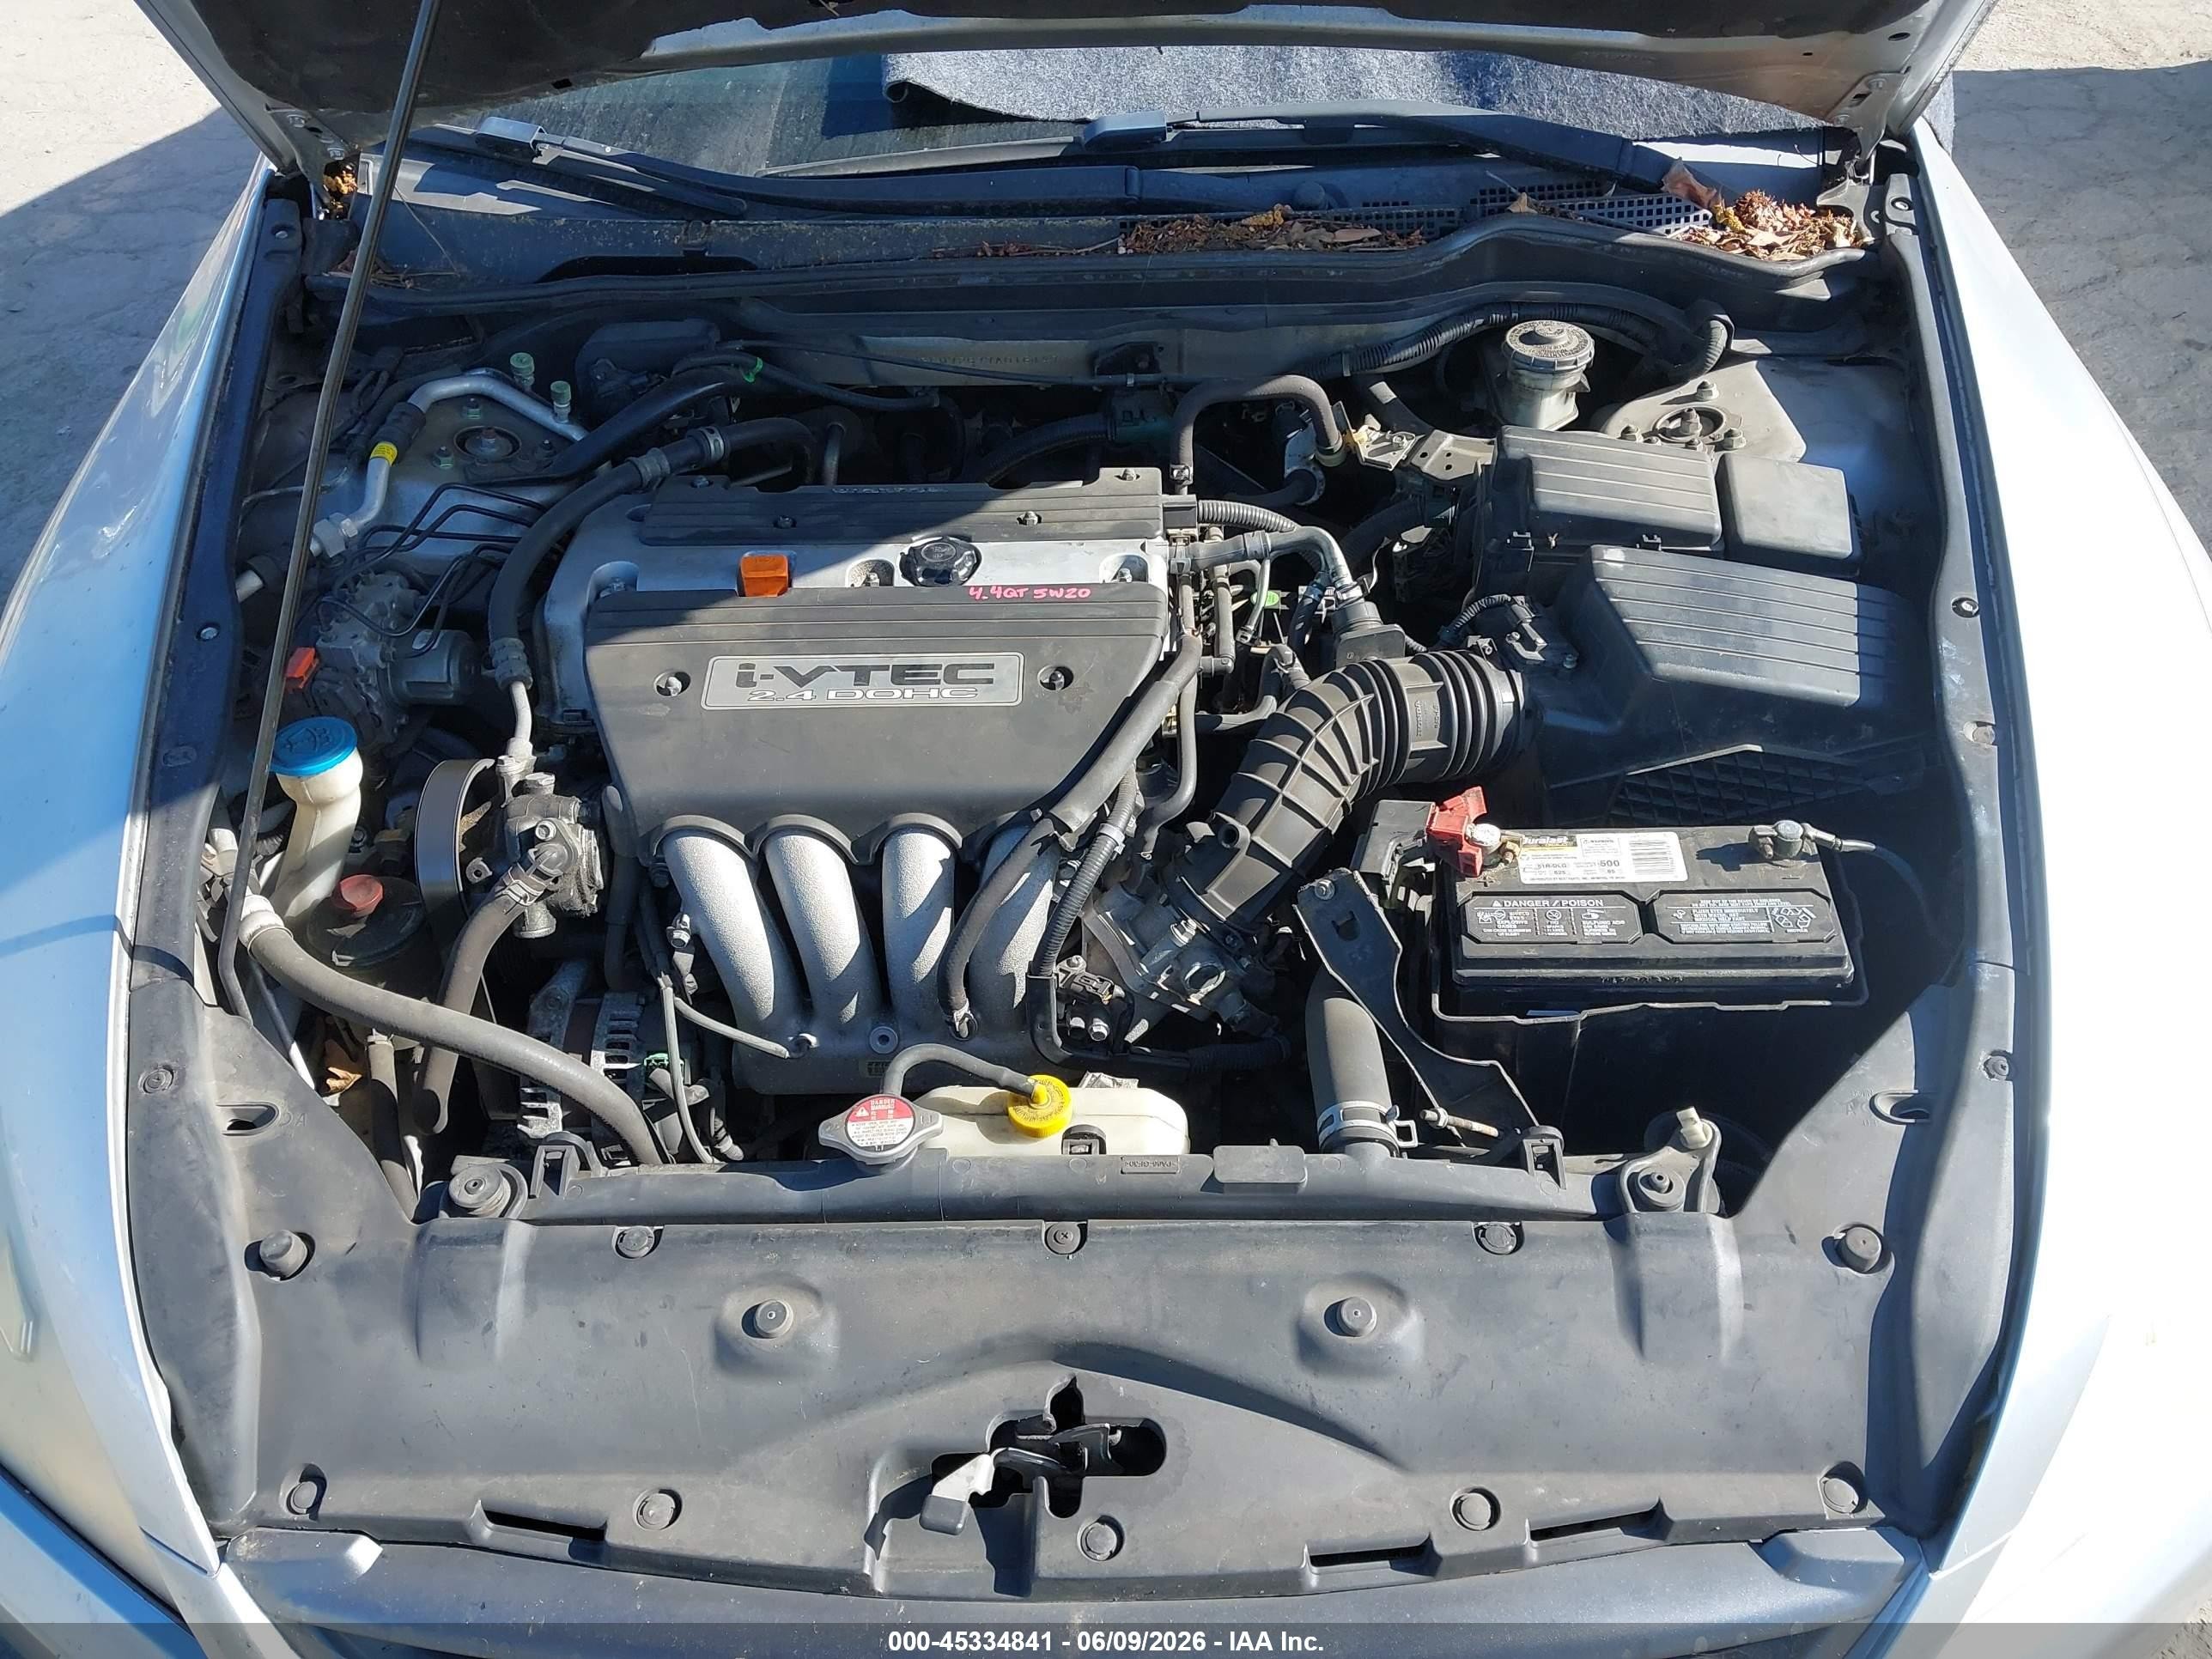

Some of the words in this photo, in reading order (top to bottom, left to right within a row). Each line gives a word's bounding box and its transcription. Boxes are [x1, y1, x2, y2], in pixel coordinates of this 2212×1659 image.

[1033, 587, 1091, 599] 5W20
[735, 662, 995, 688] i-VTEC
[747, 689, 817, 702] 2.4
[825, 687, 979, 701] DOHC
